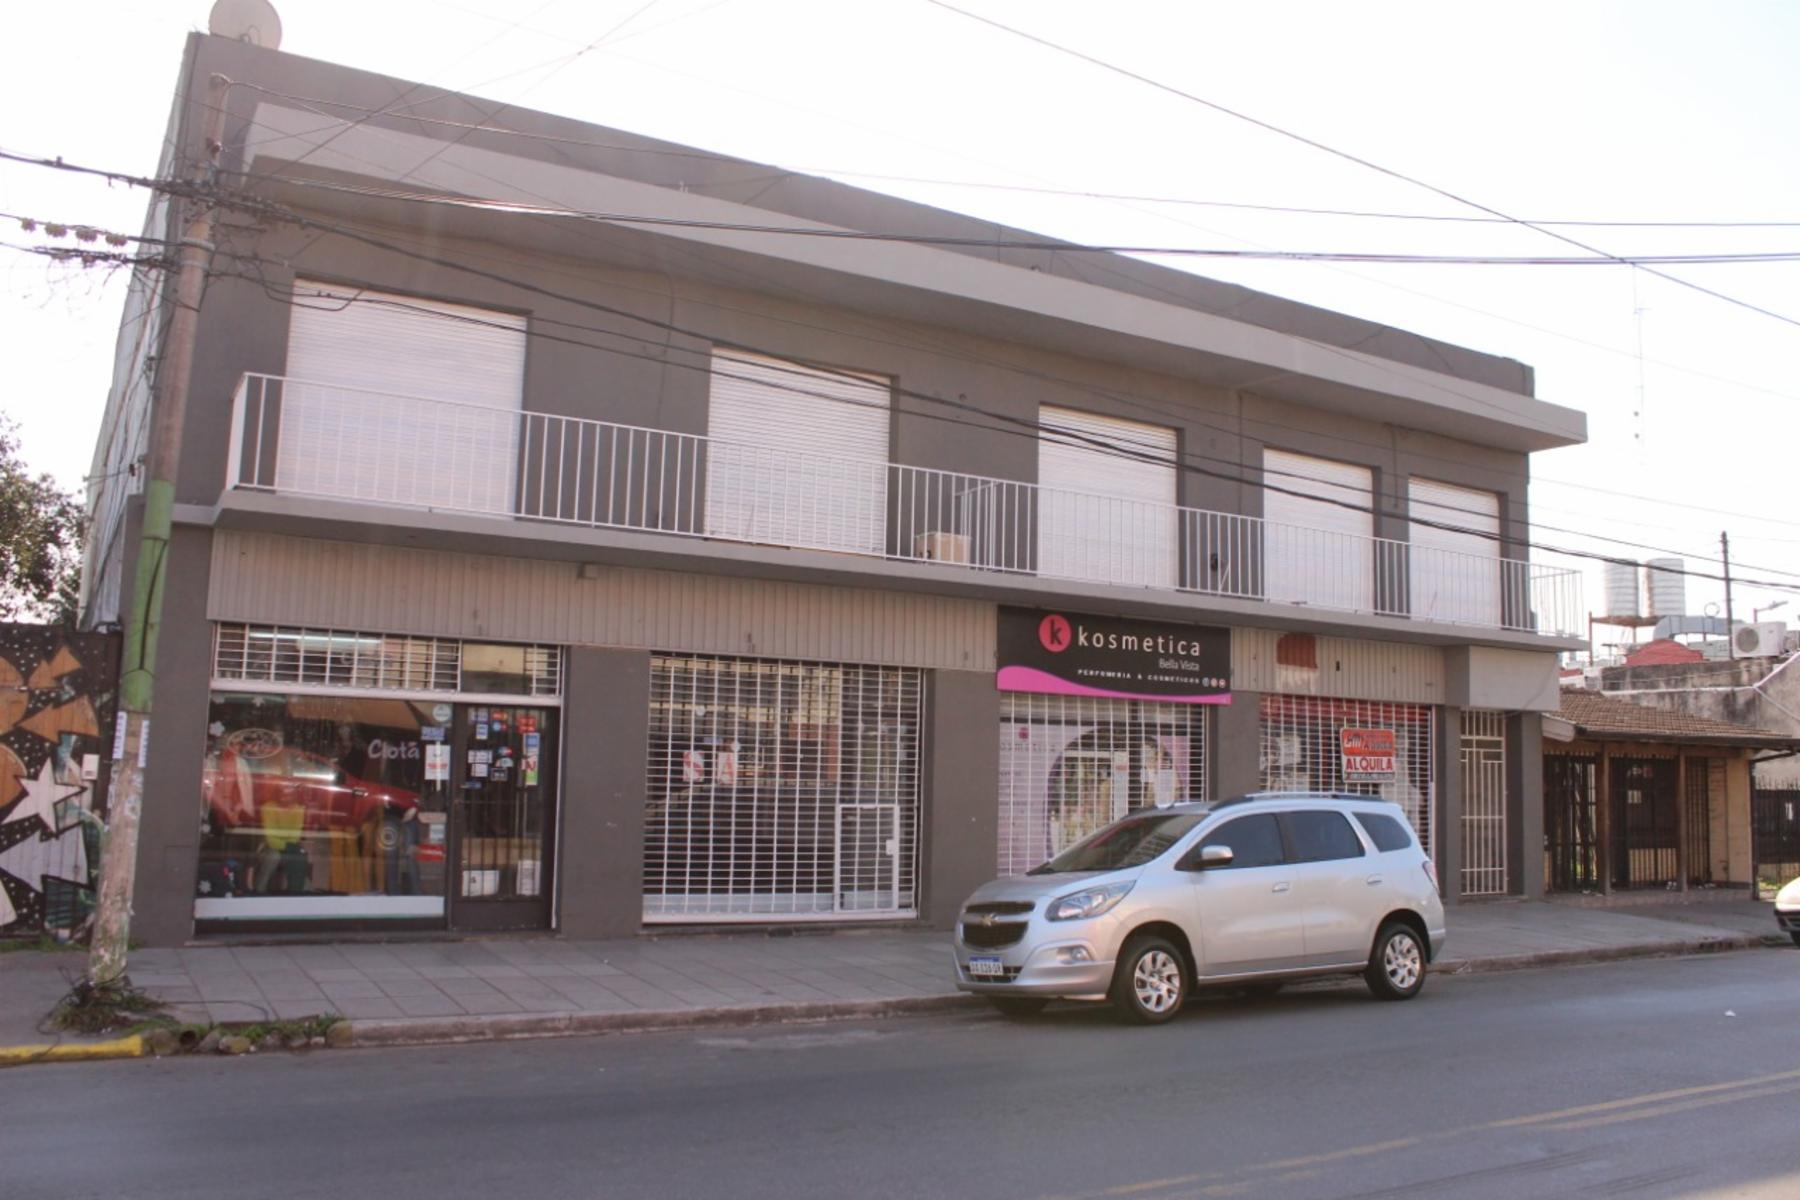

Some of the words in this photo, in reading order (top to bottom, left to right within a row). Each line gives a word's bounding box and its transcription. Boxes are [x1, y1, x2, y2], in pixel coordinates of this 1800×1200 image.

[1050, 618, 1063, 646] k
[1078, 625, 1200, 657] kosmetica
[1159, 658, 1178, 670] Bella
[1181, 660, 1200, 671] Vista
[1346, 756, 1393, 771] ALQUILA
